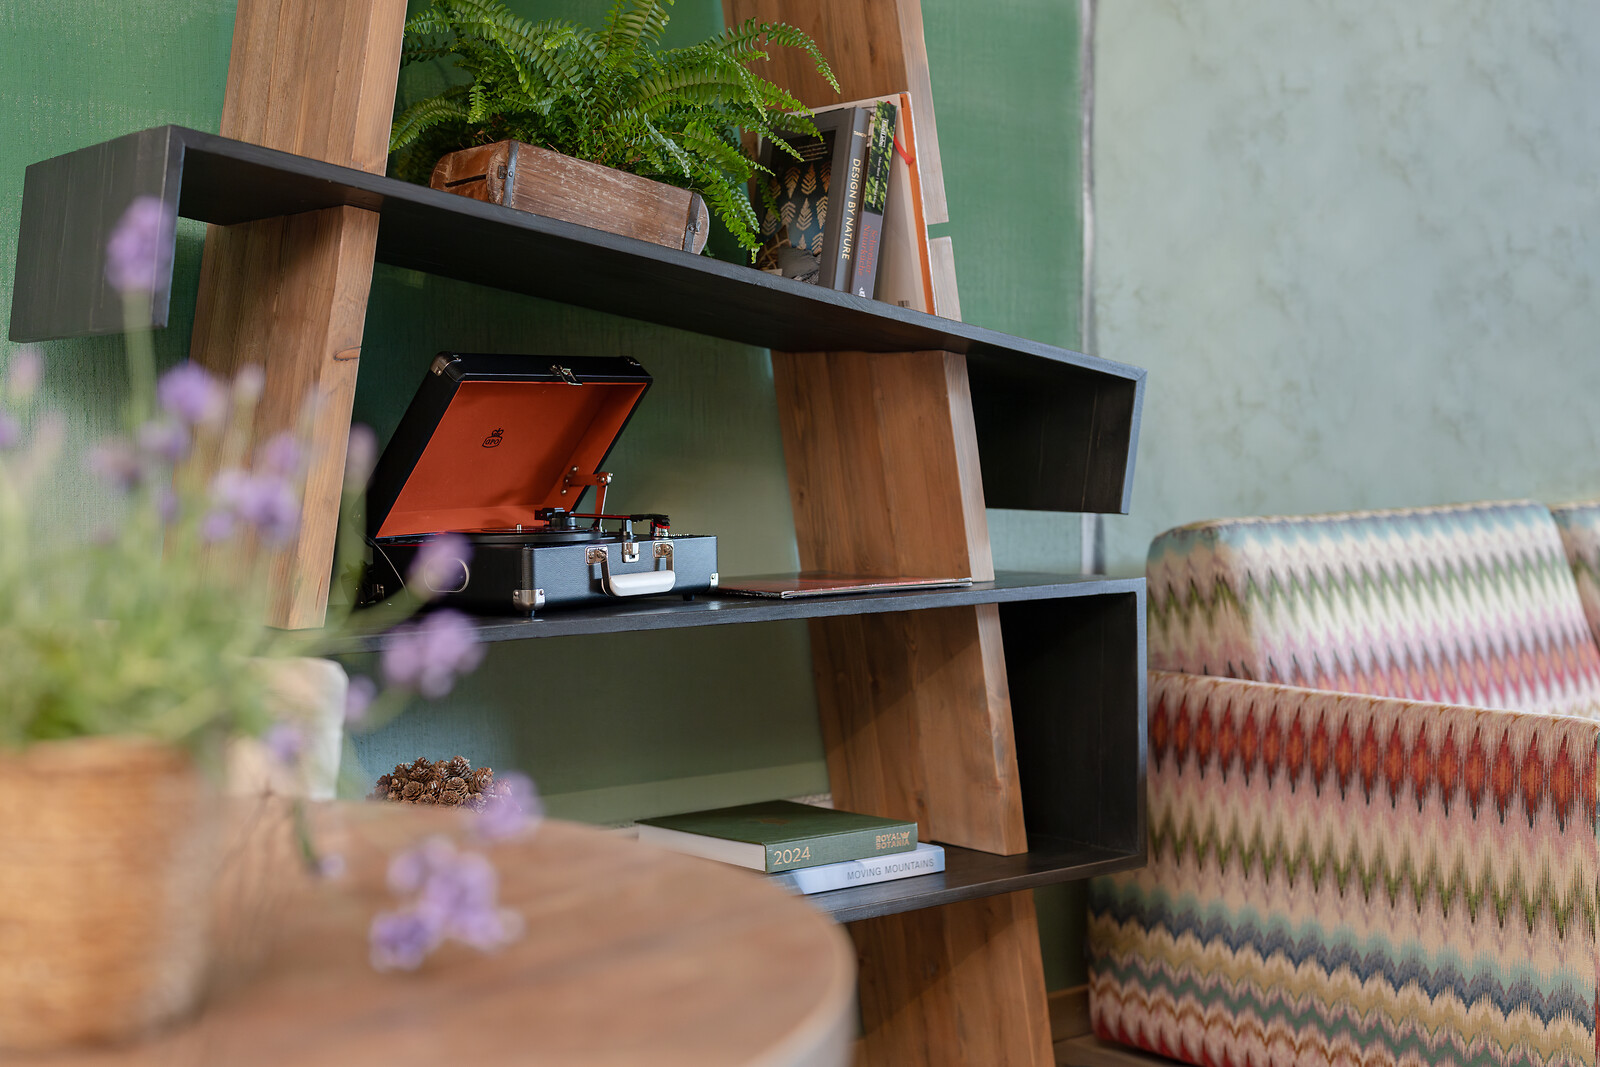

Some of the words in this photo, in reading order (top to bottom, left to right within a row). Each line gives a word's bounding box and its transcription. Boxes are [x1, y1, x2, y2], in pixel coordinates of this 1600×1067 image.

[849, 158, 861, 199] DESIGN
[847, 201, 857, 215] BY
[841, 216, 855, 260] NATURE
[858, 224, 871, 276] Naturküche
[866, 229, 878, 275] Schweizer
[876, 832, 901, 844] ROYAL
[876, 839, 910, 850] BOTANIA
[773, 846, 811, 865] 2024
[847, 866, 882, 880] MOVING
[885, 858, 935, 874] MOUNTAINS
